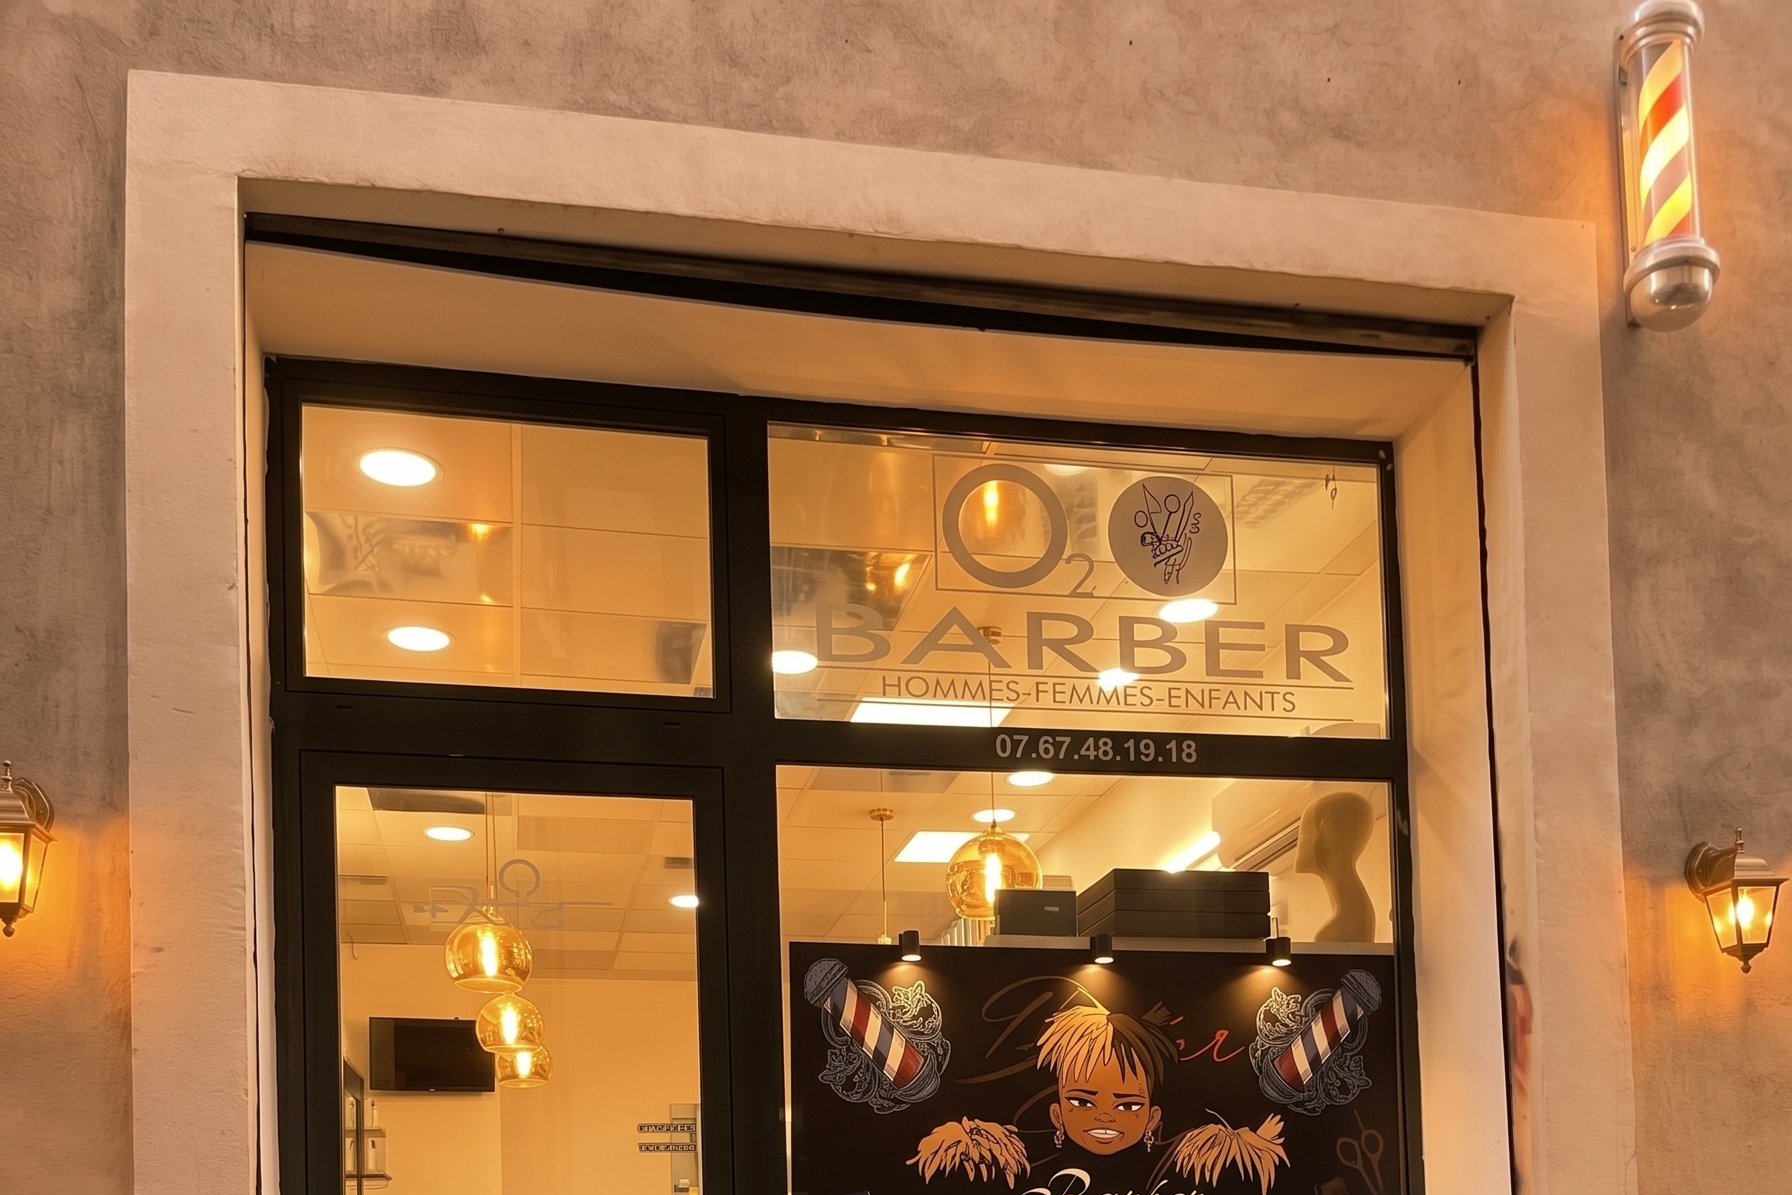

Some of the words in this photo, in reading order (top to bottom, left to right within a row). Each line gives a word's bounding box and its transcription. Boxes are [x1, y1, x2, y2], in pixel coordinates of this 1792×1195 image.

[815, 602, 1353, 683] BARBER
[881, 674, 1297, 714] HOMMES-FEMMES-ENFANTS
[995, 733, 1198, 764] 07.67.48.19.18
